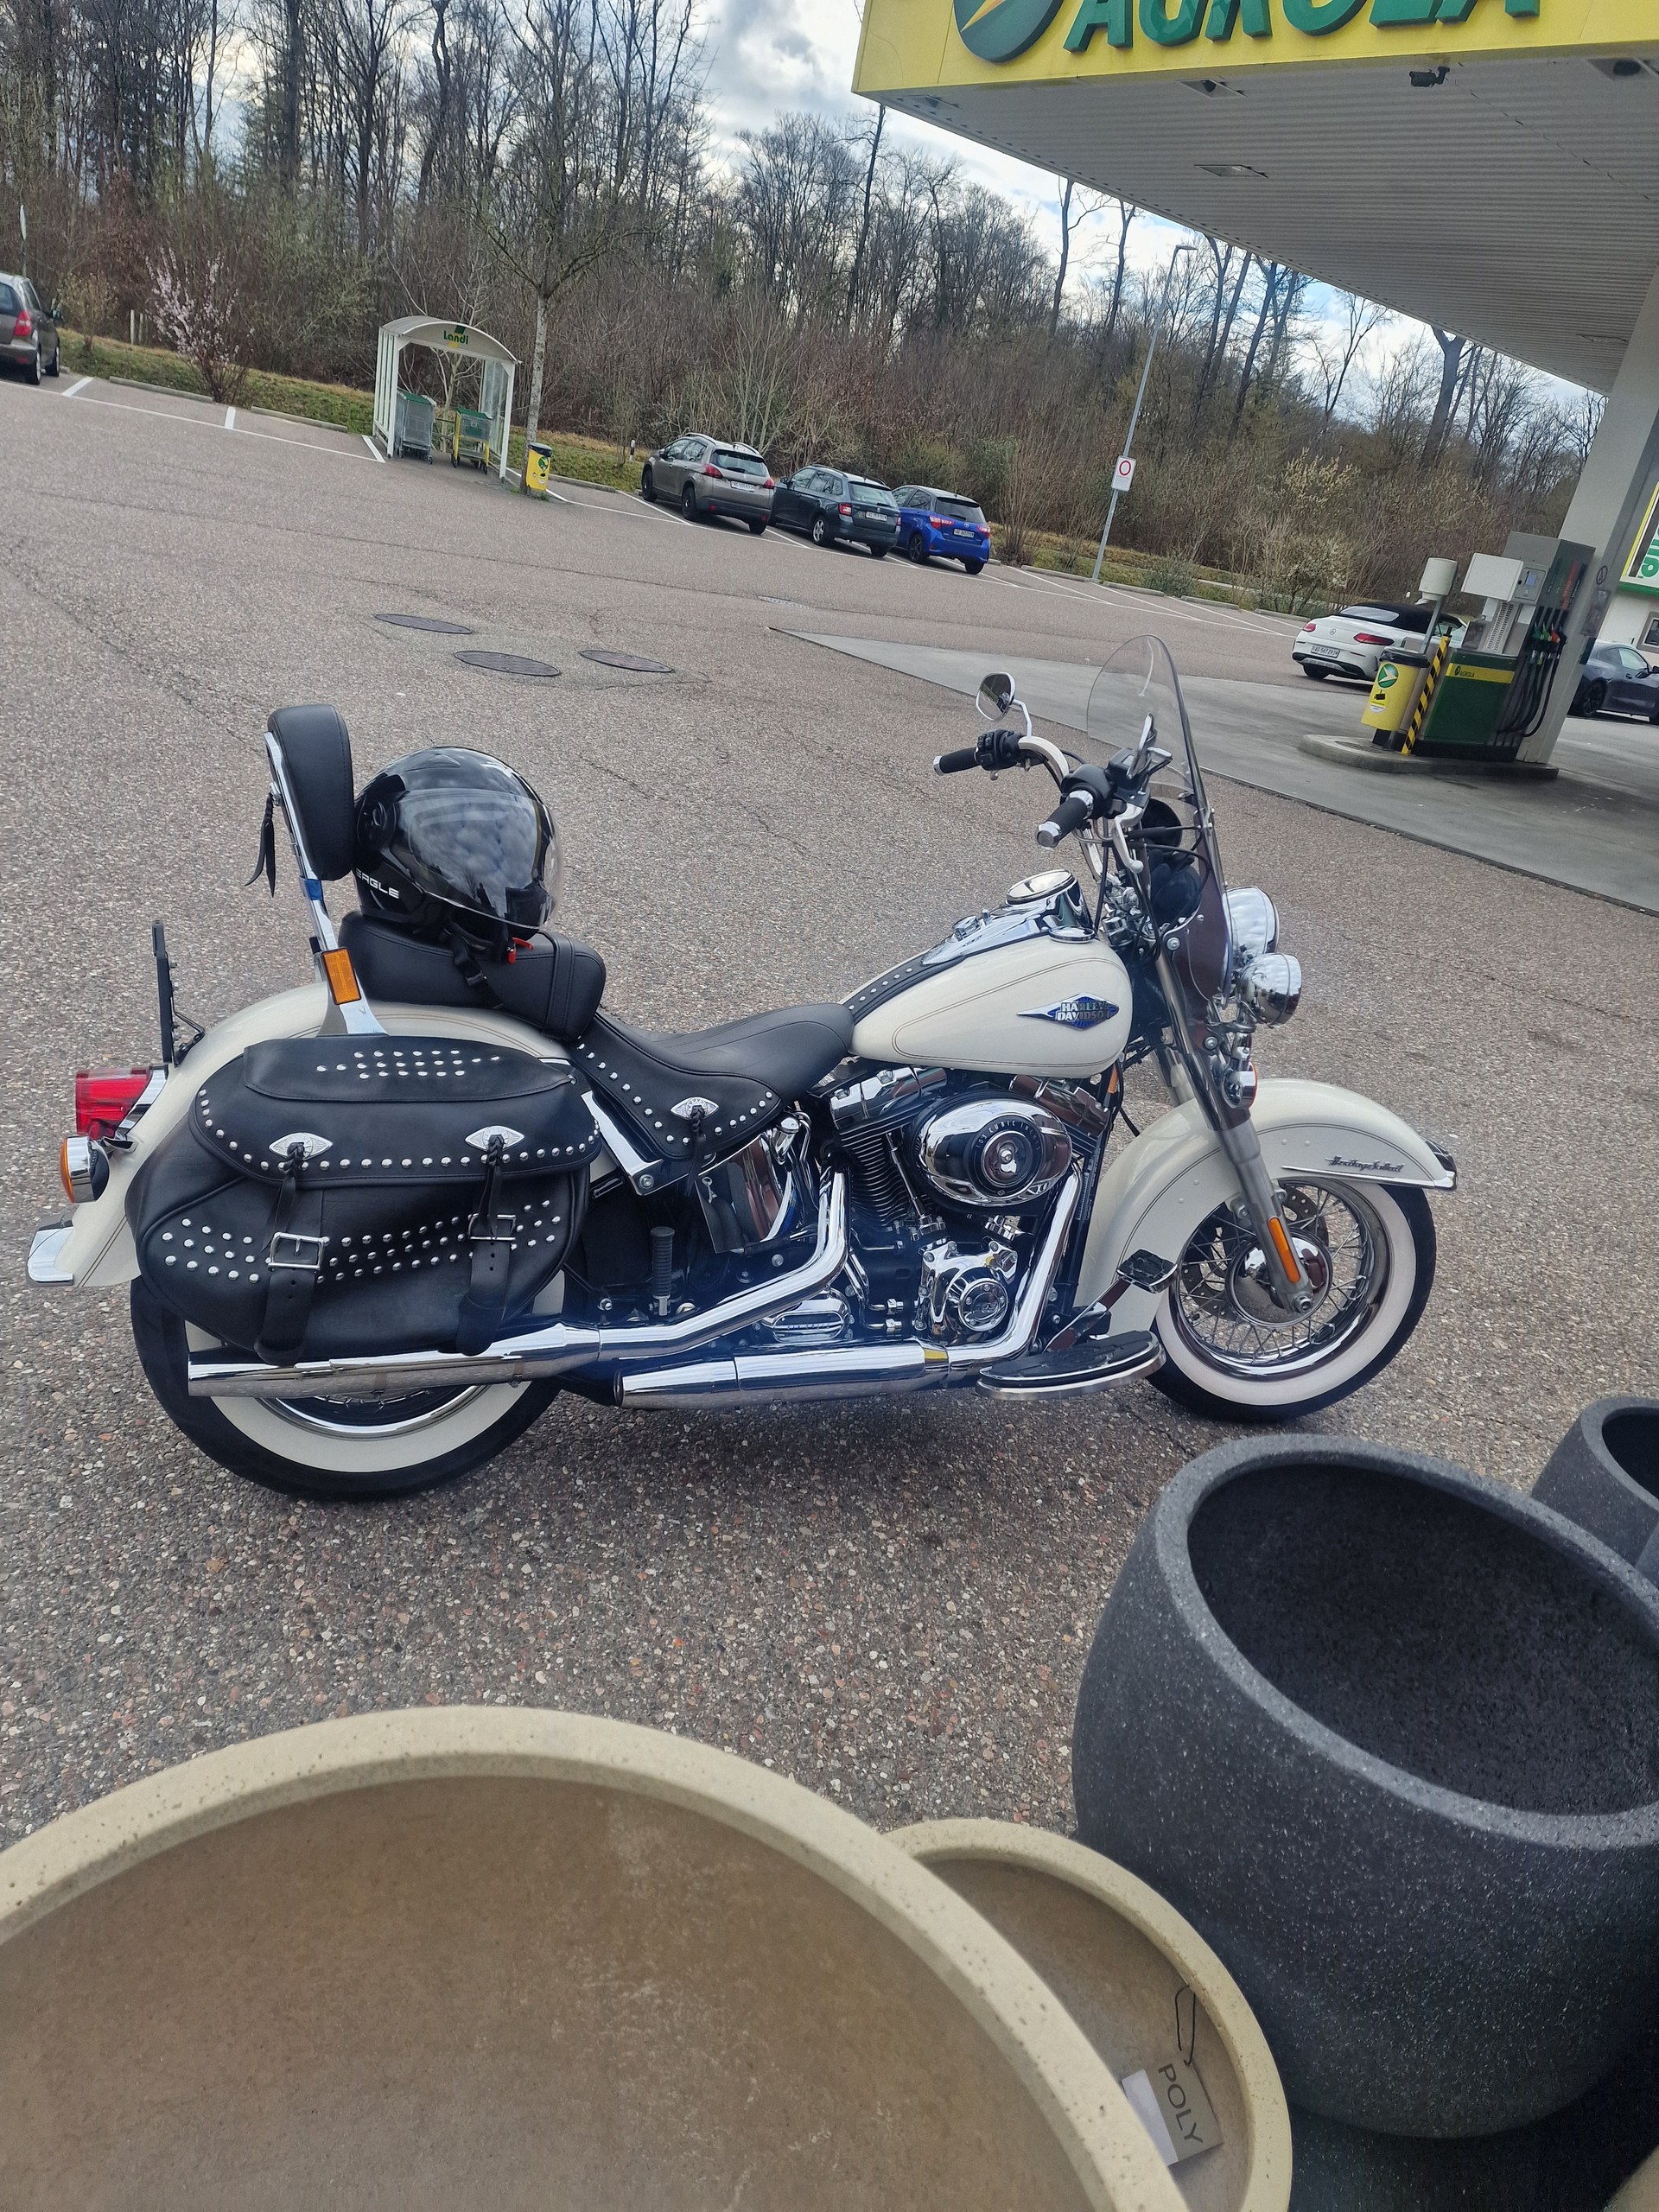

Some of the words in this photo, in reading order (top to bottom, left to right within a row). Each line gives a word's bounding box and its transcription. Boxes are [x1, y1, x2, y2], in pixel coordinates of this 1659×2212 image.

[355, 868, 400, 899] EAGLE
[988, 1120, 1016, 1134] CUBIC
[1158, 2063, 1204, 2144] POLY
